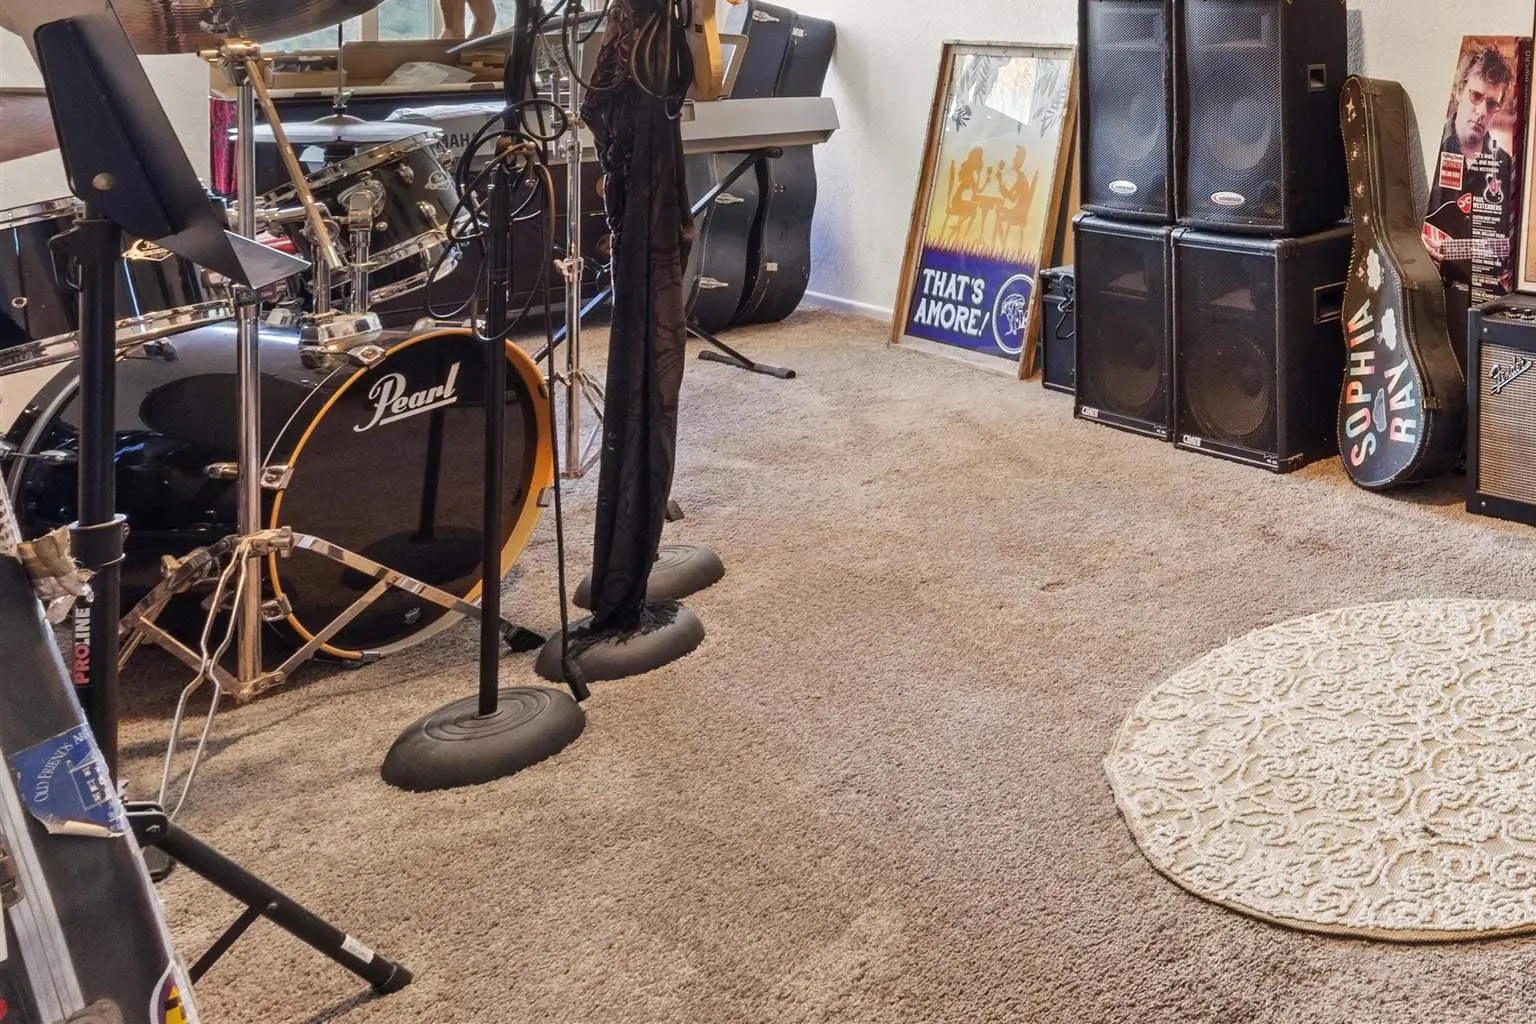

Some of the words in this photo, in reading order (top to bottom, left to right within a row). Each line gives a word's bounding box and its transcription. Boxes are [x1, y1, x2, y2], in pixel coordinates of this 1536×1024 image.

[923, 268, 985, 305] THAT'S
[913, 297, 990, 337] AMORE!
[1345, 298, 1377, 467] SOPHIA
[1488, 354, 1534, 396] Fender
[353, 361, 461, 433] Pearl
[1383, 358, 1417, 444] RAY
[74, 606, 91, 686] PROLINE
[38, 743, 74, 781] FRIENDS
[33, 777, 49, 803] OLD
